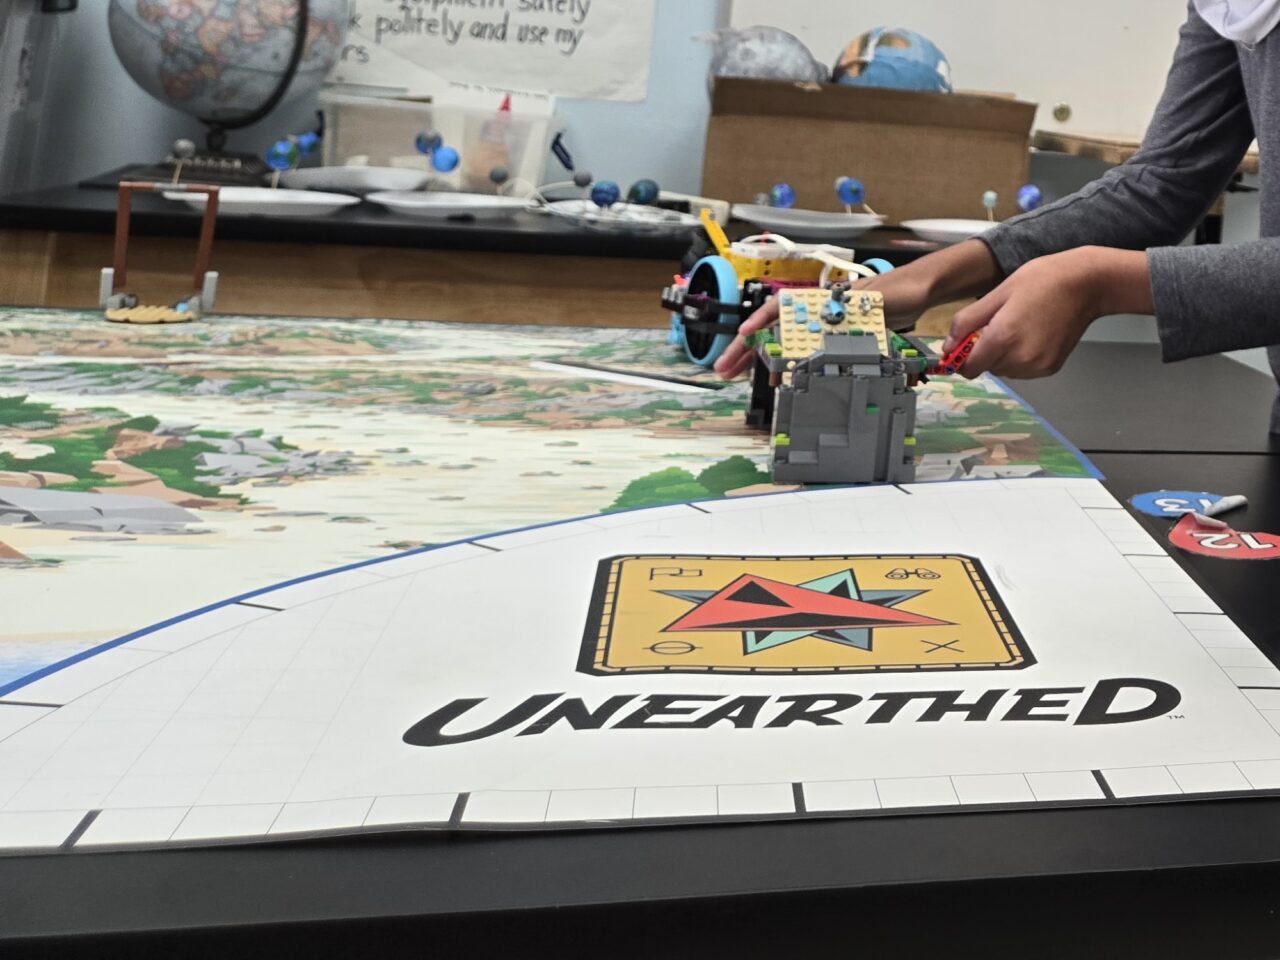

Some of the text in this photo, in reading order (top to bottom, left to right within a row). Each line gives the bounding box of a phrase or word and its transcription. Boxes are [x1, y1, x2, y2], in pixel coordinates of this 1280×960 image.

[468, 10, 510, 43] and
[516, 23, 550, 45] use
[554, 26, 585, 56] my
[402, 677, 1182, 748] UNEARTHED
